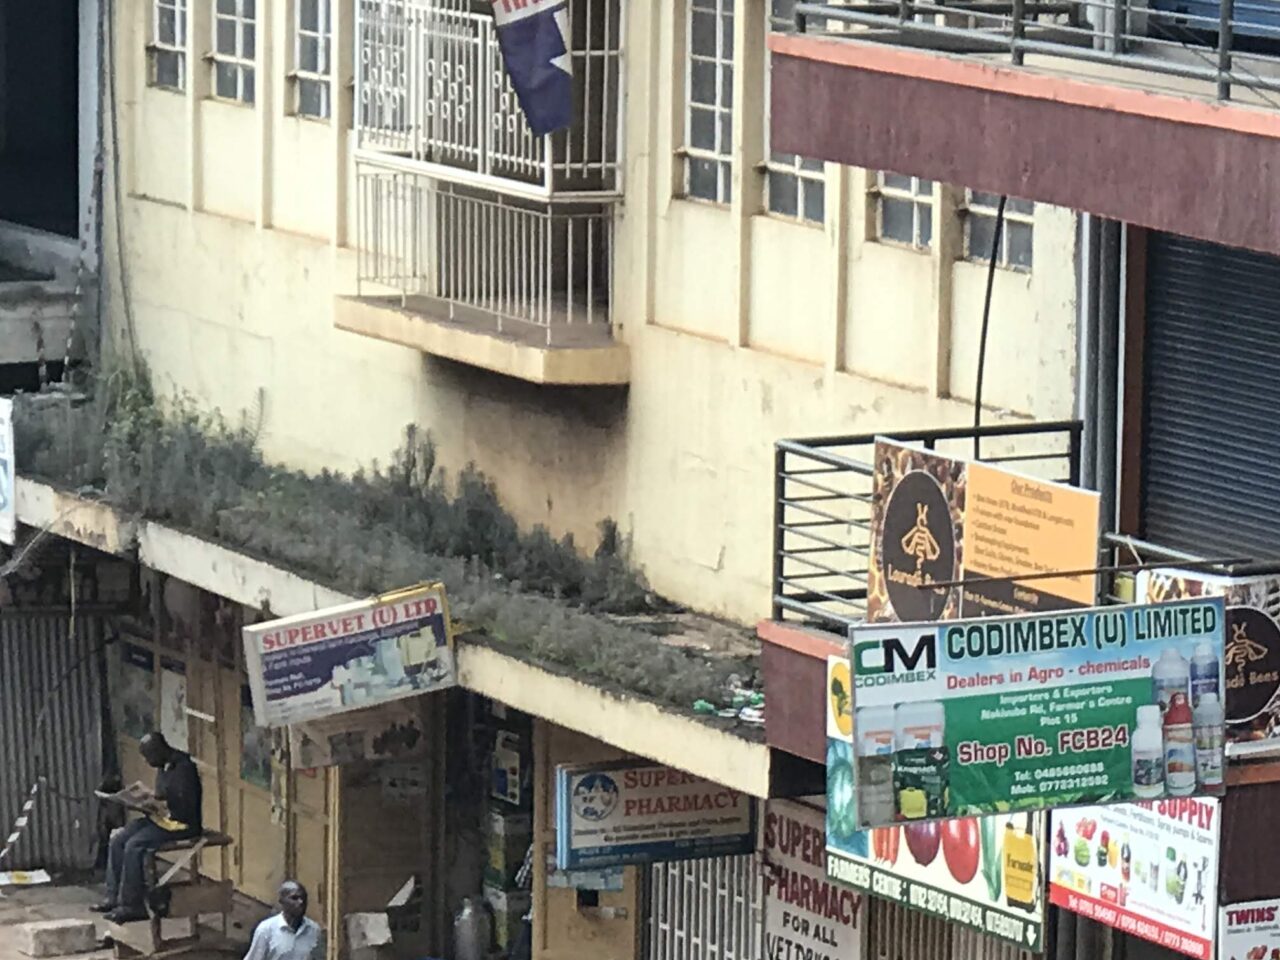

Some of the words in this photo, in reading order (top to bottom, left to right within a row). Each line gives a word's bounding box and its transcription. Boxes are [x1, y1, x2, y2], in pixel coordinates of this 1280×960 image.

[262, 613, 365, 650] SUPERVET
[371, 605, 398, 629] (U)
[404, 597, 437, 619] LTD
[947, 615, 1087, 660] CODIMBEX
[1095, 612, 1126, 649] (U)
[1135, 604, 1216, 641] LIMITED
[855, 669, 937, 689] CODIMBEX
[947, 673, 1005, 690] Dealers
[1010, 669, 1022, 684] in
[1028, 667, 1064, 686] Agro
[1078, 655, 1151, 676] chemicals
[1063, 684, 1113, 699] Exporters
[957, 740, 1011, 767] Shop
[1015, 735, 1053, 758] No.
[1058, 723, 1130, 756] FCB24
[624, 791, 743, 817] PHARMACY
[761, 861, 863, 931] PHARMACY
[783, 911, 810, 938] FOR
[813, 921, 838, 948] ALL
